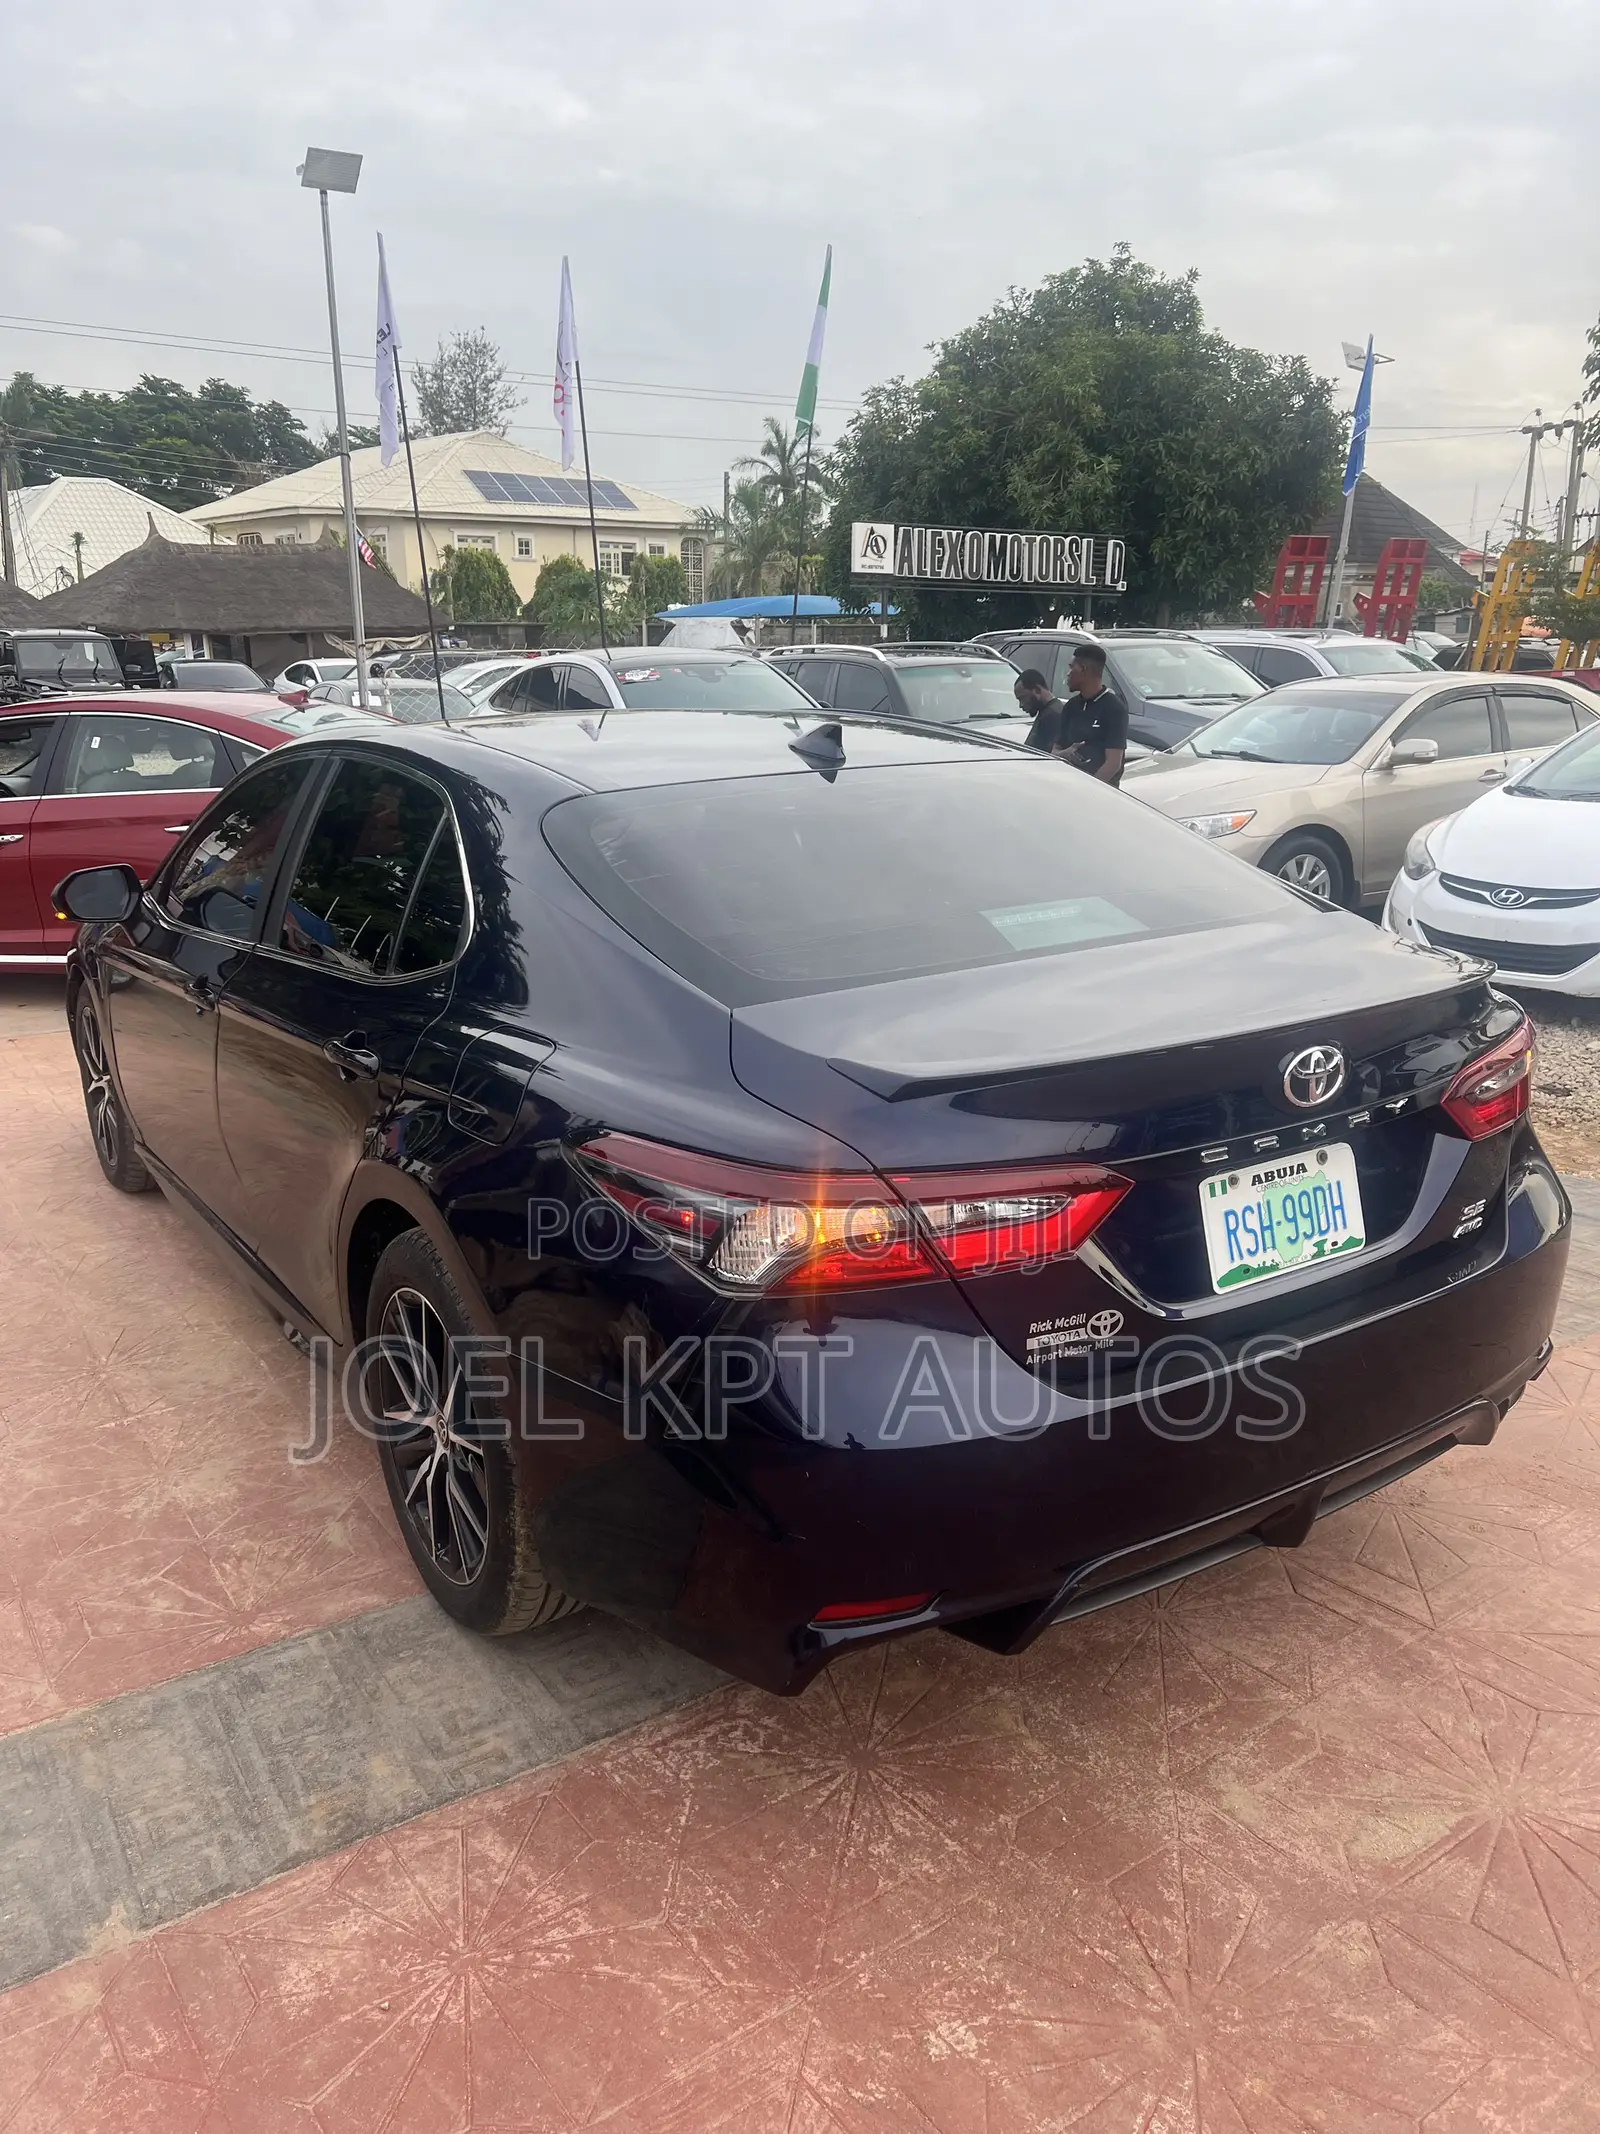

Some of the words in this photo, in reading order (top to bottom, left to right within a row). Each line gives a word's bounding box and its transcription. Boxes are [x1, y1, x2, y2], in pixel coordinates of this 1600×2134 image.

[1251, 1163, 1308, 1186] ABUJA
[1461, 1199, 1487, 1221] SE
[1223, 1180, 1348, 1263] RSH-99DH
[1029, 1319, 1052, 1334] Rick
[1054, 1312, 1087, 1329] McGill
[1036, 1329, 1081, 1347] TOYOTA
[1026, 1349, 1063, 1365] Airport
[1064, 1343, 1092, 1357] Motor
[1095, 1338, 1114, 1350] Mile
